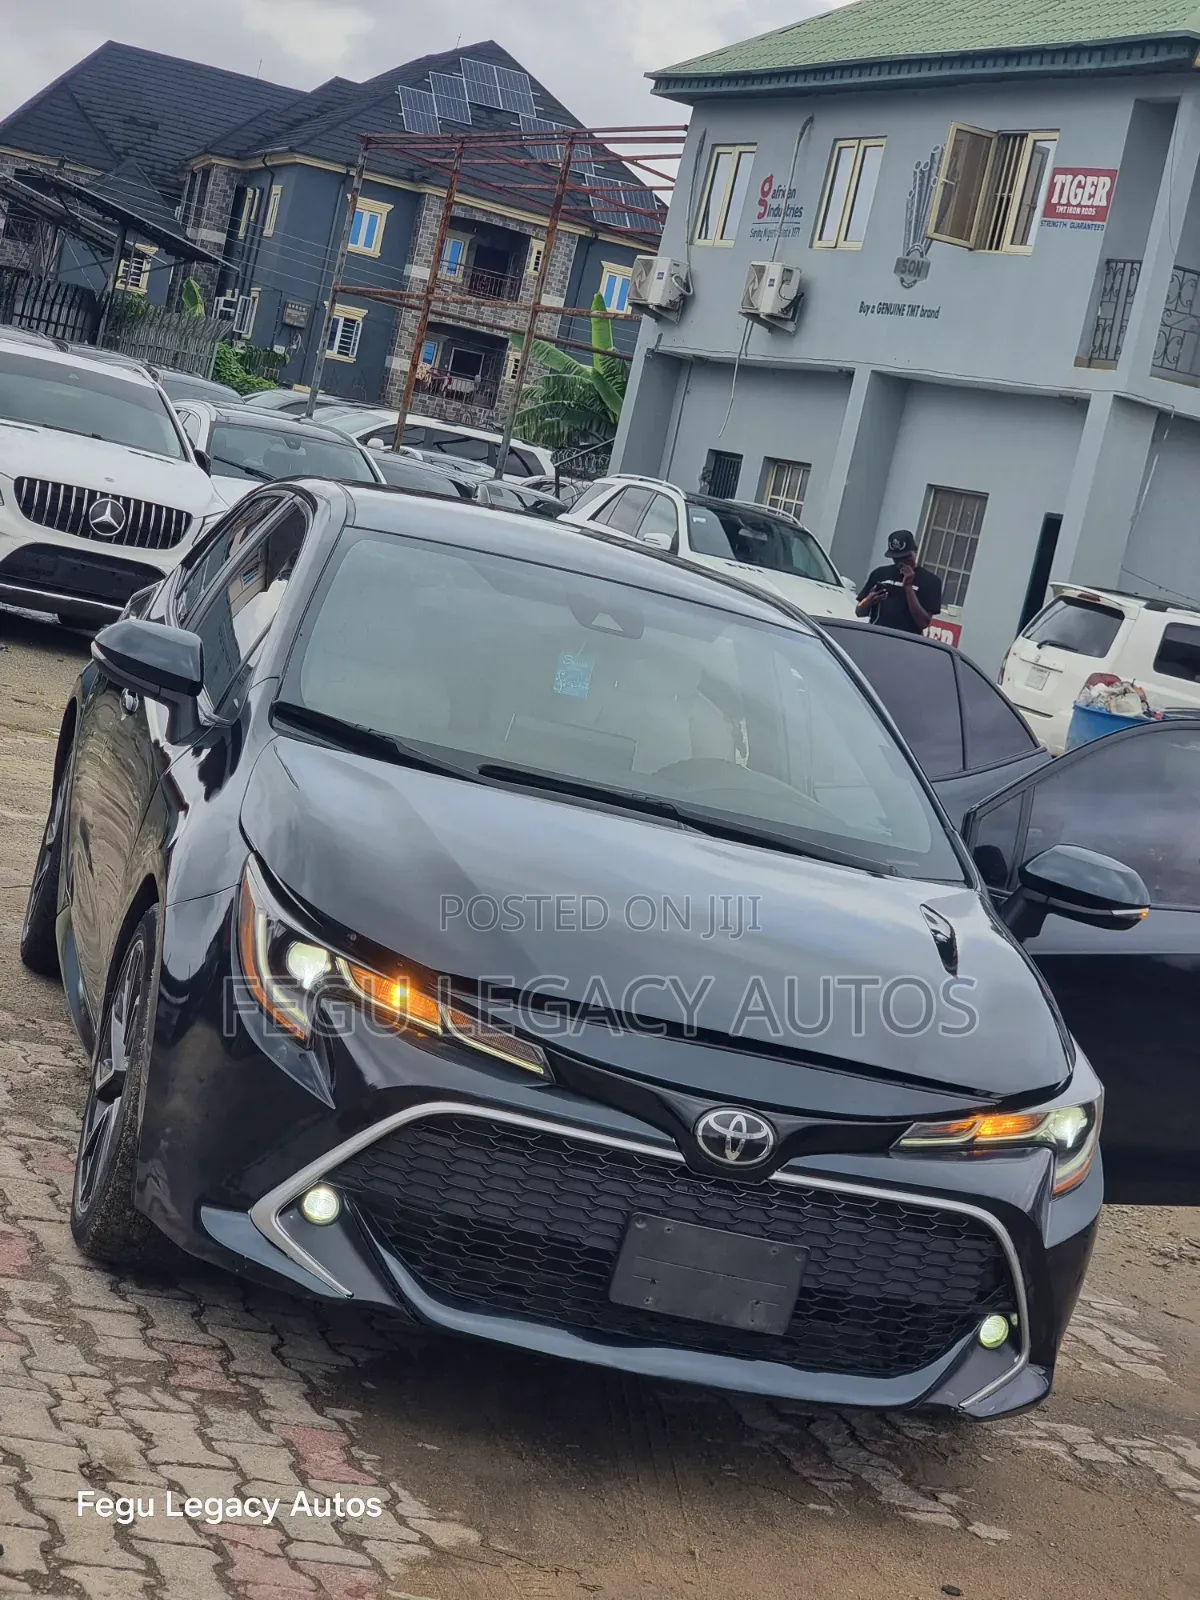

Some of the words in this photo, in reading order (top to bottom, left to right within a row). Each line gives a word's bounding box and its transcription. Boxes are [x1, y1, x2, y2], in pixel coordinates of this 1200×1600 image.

[771, 185, 796, 199] afrian
[1051, 174, 1111, 206] TIGER
[767, 204, 803, 218] Indutries
[1040, 220, 1067, 228] STRENGTH
[1069, 222, 1105, 231] GUARANTEED
[900, 259, 924, 277] SON
[859, 301, 871, 316] Buy
[871, 305, 876, 314] a
[877, 302, 906, 316] GENUINE
[906, 304, 920, 317] TMT
[919, 305, 941, 319] brand
